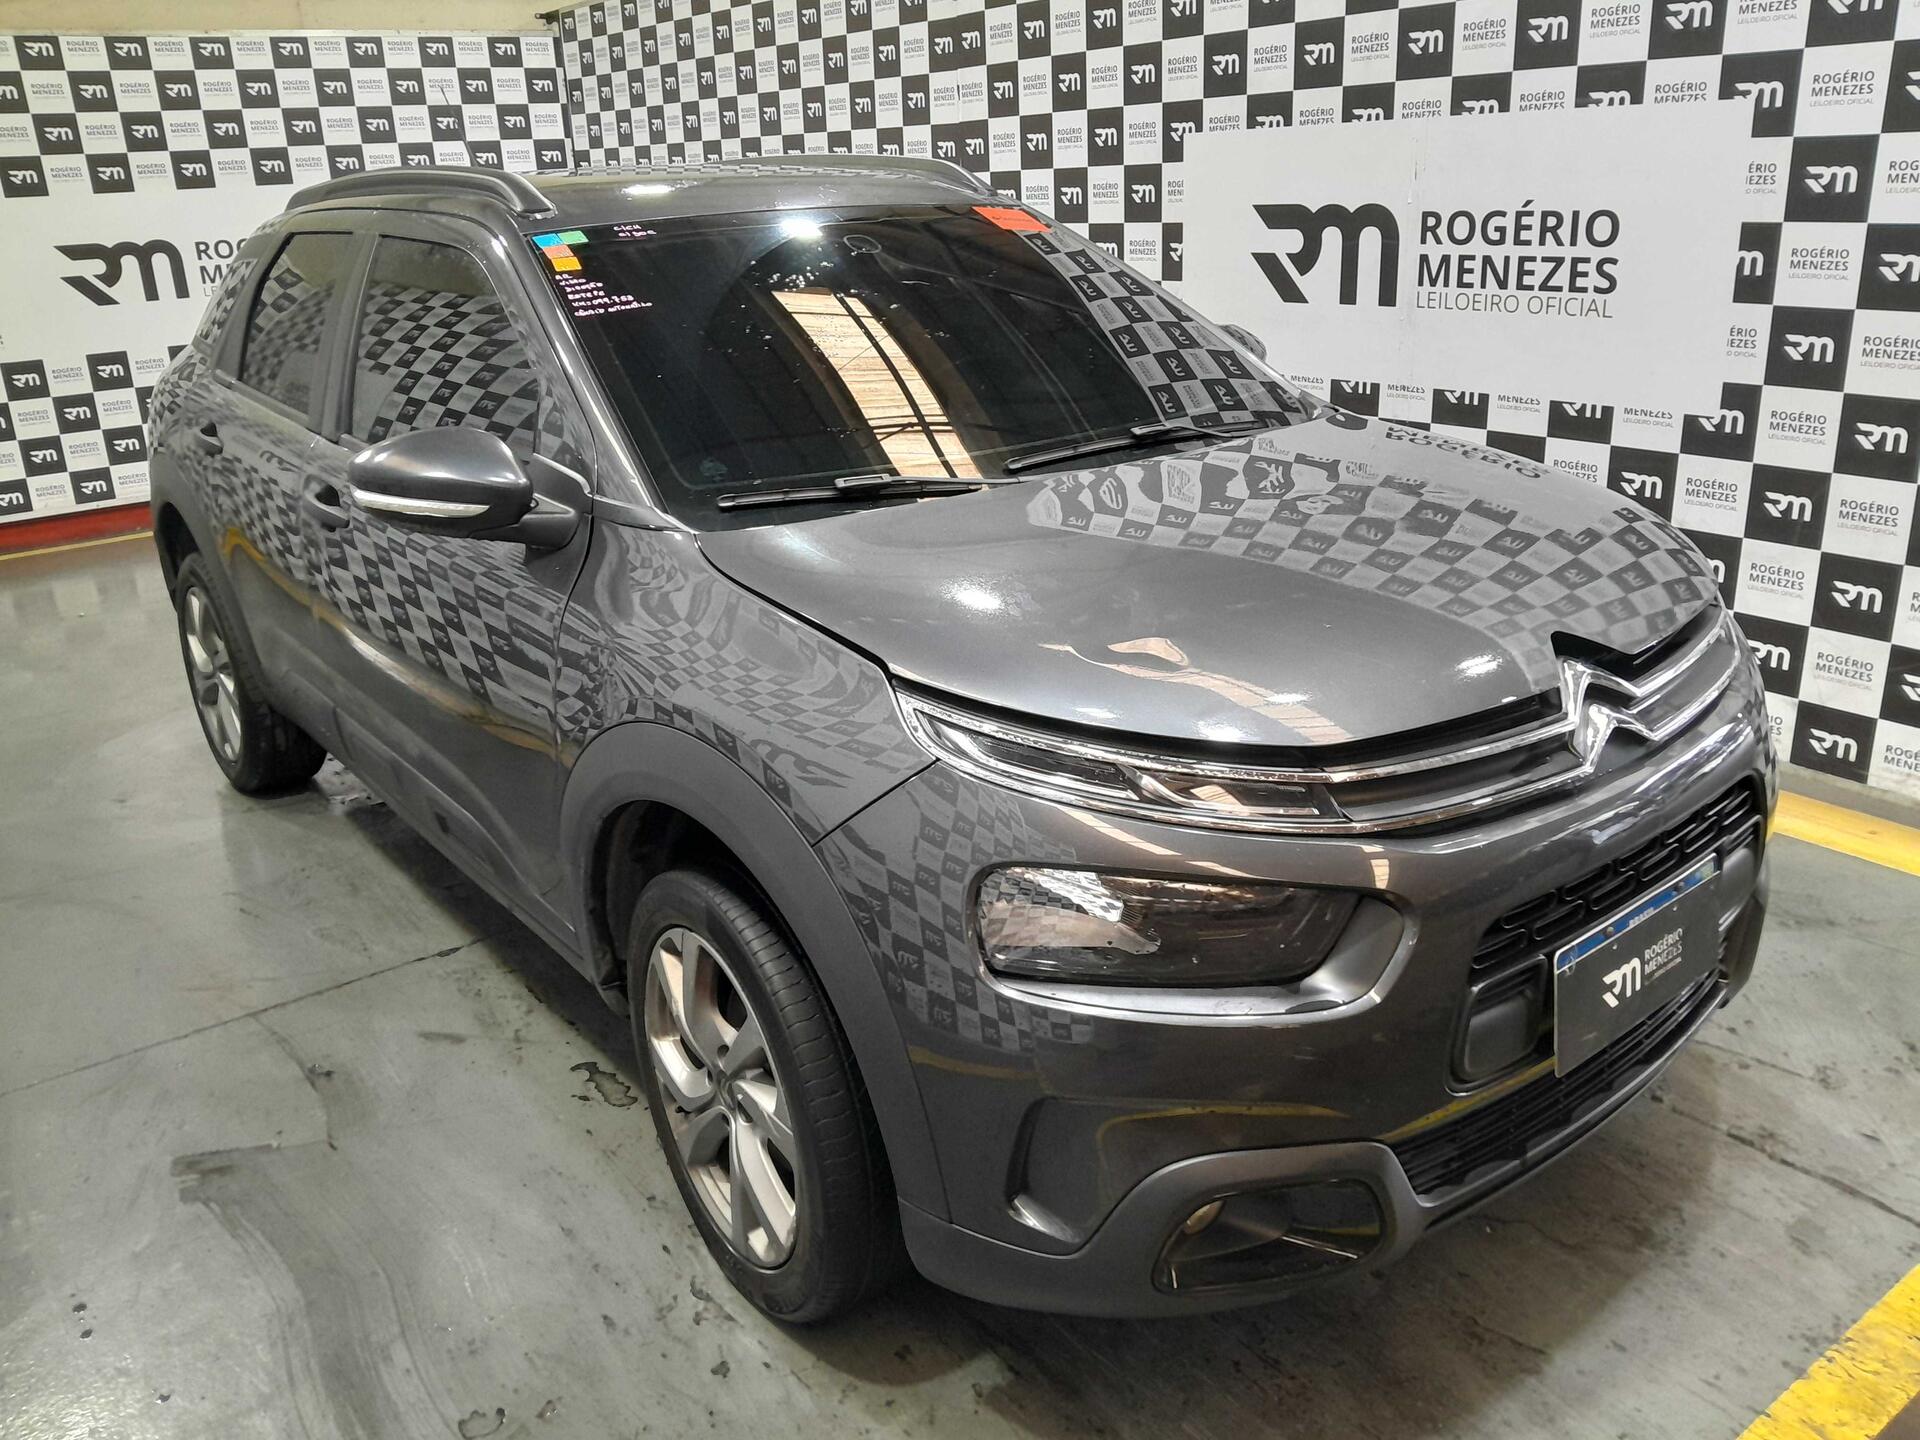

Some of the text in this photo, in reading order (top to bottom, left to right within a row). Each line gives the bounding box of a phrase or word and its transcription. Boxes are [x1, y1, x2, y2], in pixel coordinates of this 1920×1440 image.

[1128, 0, 1156, 9] ROGÉRIO
[1592, 3, 1640, 18] ROGÉRIO
[1739, 0, 1797, 14] MENEZES
[1055, 10, 1080, 21] ROGÉRIO
[1128, 7, 1156, 17] MENEZES
[990, 22, 1012, 32] ROGÉRIO
[1056, 19, 1080, 29] MENEZES
[1464, 18, 1506, 32] ROGÉRIO
[1590, 15, 1640, 29] MENEZES
[990, 30, 1012, 40] MENEZES
[1352, 32, 1389, 44] ROGÉRIO
[1463, 29, 1506, 42] MENEZES
[1254, 44, 1287, 56] ROGÉRIO
[1352, 42, 1389, 54] MENEZES
[1168, 56, 1197, 66] ROGÉRIO
[1254, 54, 1287, 64] MENEZES
[1092, 65, 1117, 74] ROGÉRIO
[1168, 64, 1197, 74] MENEZES
[1023, 74, 1046, 82] ROGÉRIO
[1092, 73, 1120, 83] MENEZES
[1813, 70, 1874, 84] ROGÉRIO
[1023, 82, 1047, 90] MENEZES
[1655, 80, 1707, 94] ROGÉRIO
[1811, 84, 1874, 96] MENEZES
[1520, 90, 1565, 102] ROGÉRIO
[1654, 93, 1706, 103] MENEZES
[1402, 99, 1441, 110] ROGÉRIO
[1520, 102, 1564, 110] MENEZES
[1300, 107, 1334, 118] ROGÉRIO
[1402, 110, 1441, 118] MENEZES
[1209, 114, 1240, 124] ROGÉRIO
[1299, 117, 1334, 125] MENEZES
[1129, 121, 1156, 130] ROGÉRIO
[993, 132, 1015, 140] ROGÉRIO
[1129, 130, 1156, 138] MENEZES
[993, 140, 1016, 148] MENEZES
[1748, 161, 1776, 173] ÉRIO
[1093, 182, 1118, 190] ROGÉRIO
[1746, 175, 1776, 185] EZES
[1026, 184, 1049, 192] ROGÉRIO
[1419, 199, 1620, 248] ROGÉRIO
[1791, 246, 1849, 259] ROGÉRIO
[1790, 260, 1848, 271] MENEZES
[1417, 253, 1619, 294] MENEZES
[1416, 291, 1613, 319] LEILOEIRO OFICIAL
[1730, 325, 1757, 338] ÉRIO
[1727, 338, 1756, 349] EZES
[1771, 410, 1826, 424] ROGÉRIO
[1770, 422, 1825, 436] MENEZES
[1553, 460, 1598, 473] ROGÉRIO
[1686, 478, 1738, 492] ROGÉRIO
[1686, 488, 1736, 503] MENEZES
[1840, 499, 1899, 516] ROGÉRIO
[1839, 510, 1898, 527] MENEZES
[1751, 563, 1804, 580] ROGÉRIO
[1749, 573, 1804, 590] MENEZES
[1817, 652, 1874, 671] ROGÉRIO
[1816, 662, 1872, 682] MENEZES
[1645, 928, 1682, 961] ROGÉRIO
[1645, 941, 1682, 975] MENEZES
